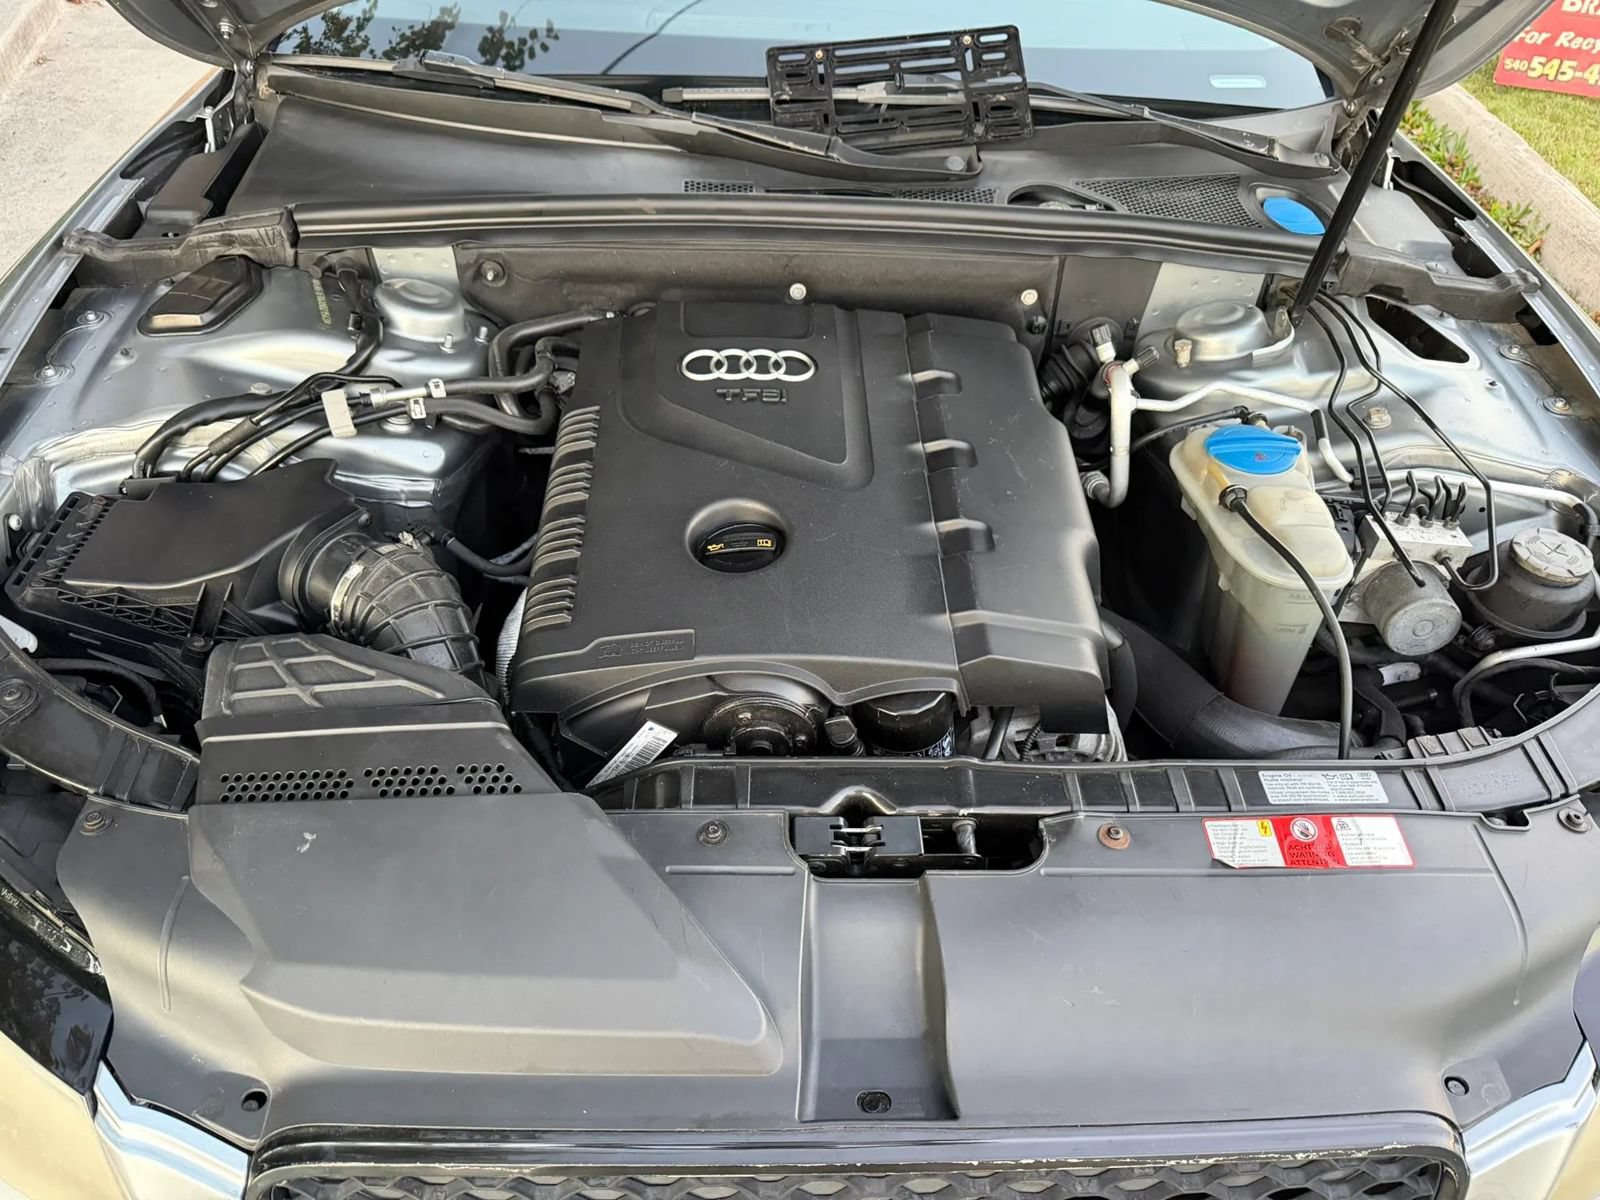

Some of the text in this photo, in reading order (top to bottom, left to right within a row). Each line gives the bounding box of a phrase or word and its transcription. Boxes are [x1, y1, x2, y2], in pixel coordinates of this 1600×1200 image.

[1561, 0, 1600, 16] BR
[1503, 55, 1600, 85] 540 545-4
